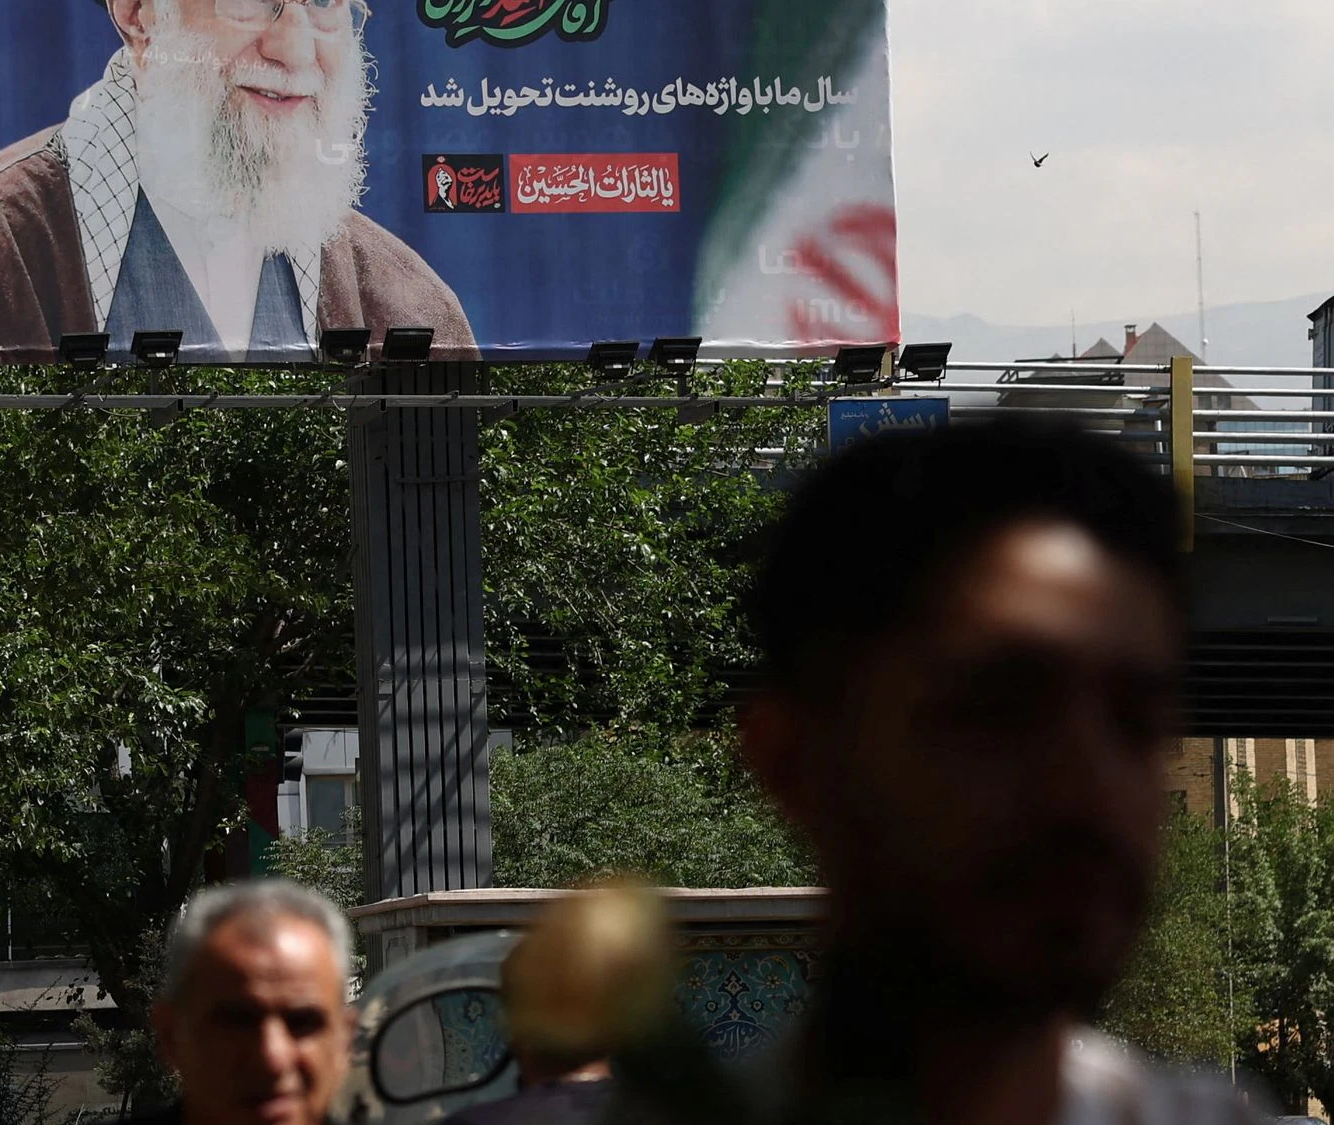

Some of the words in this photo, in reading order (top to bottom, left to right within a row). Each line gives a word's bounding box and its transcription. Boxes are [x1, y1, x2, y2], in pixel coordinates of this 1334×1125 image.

[420, 76, 465, 108] شد
[466, 76, 555, 117] تحویل
[554, 76, 651, 116] روشنت
[753, 75, 774, 115] با
[773, 75, 802, 106] ما
[803, 75, 858, 113] سال
